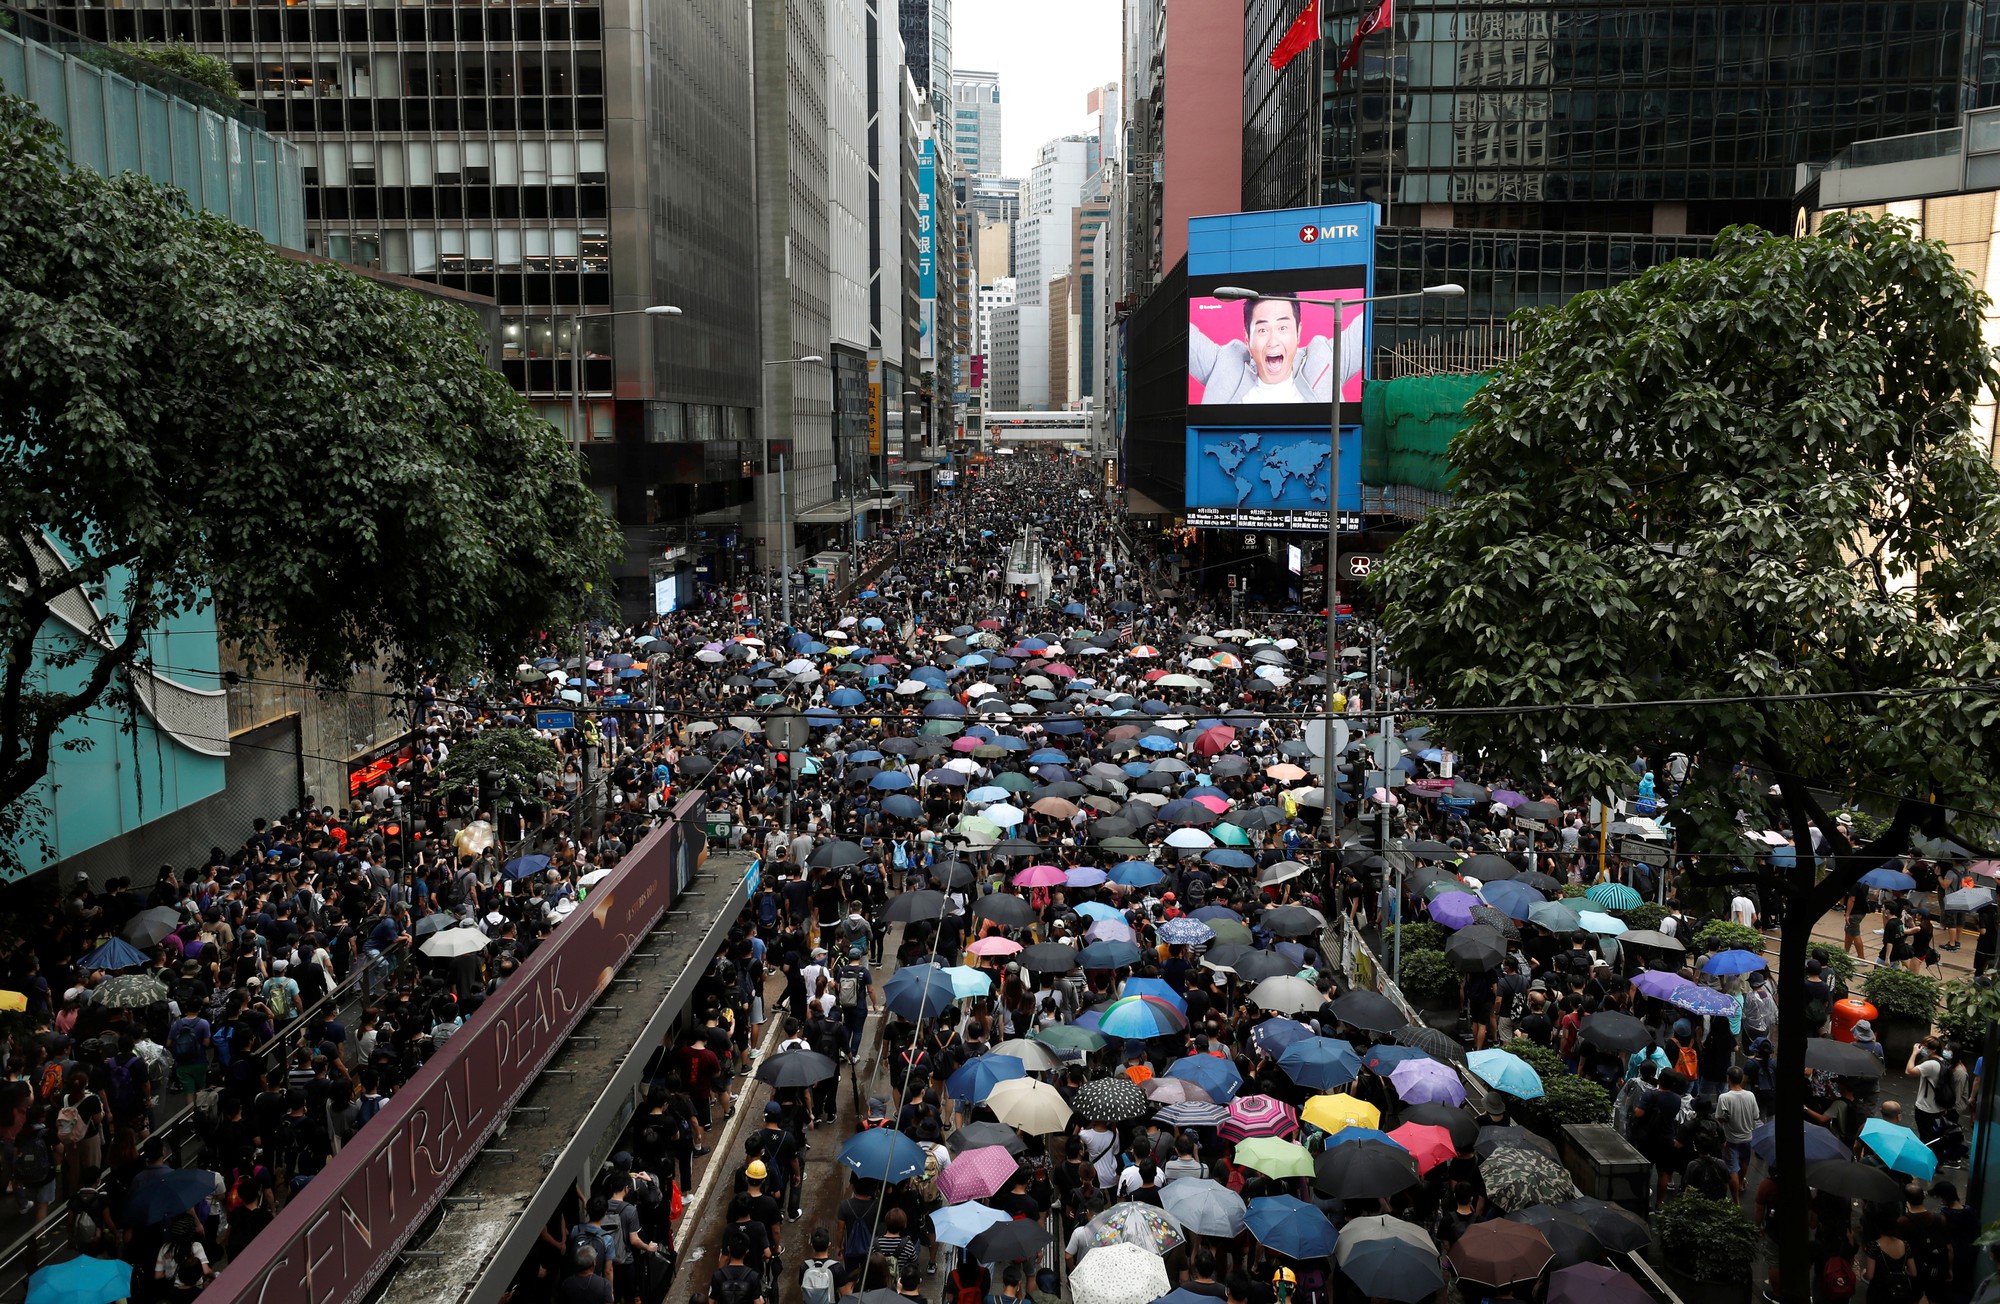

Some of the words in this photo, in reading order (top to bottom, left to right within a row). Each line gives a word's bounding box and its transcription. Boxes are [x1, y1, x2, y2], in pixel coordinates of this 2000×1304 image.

[1134, 120, 1145, 253] SIBERIAN
[1320, 224, 1359, 240] MTR
[1639, 846, 1653, 854] Road
[646, 879, 658, 900] ROAD
[495, 956, 579, 1092] PEAK
